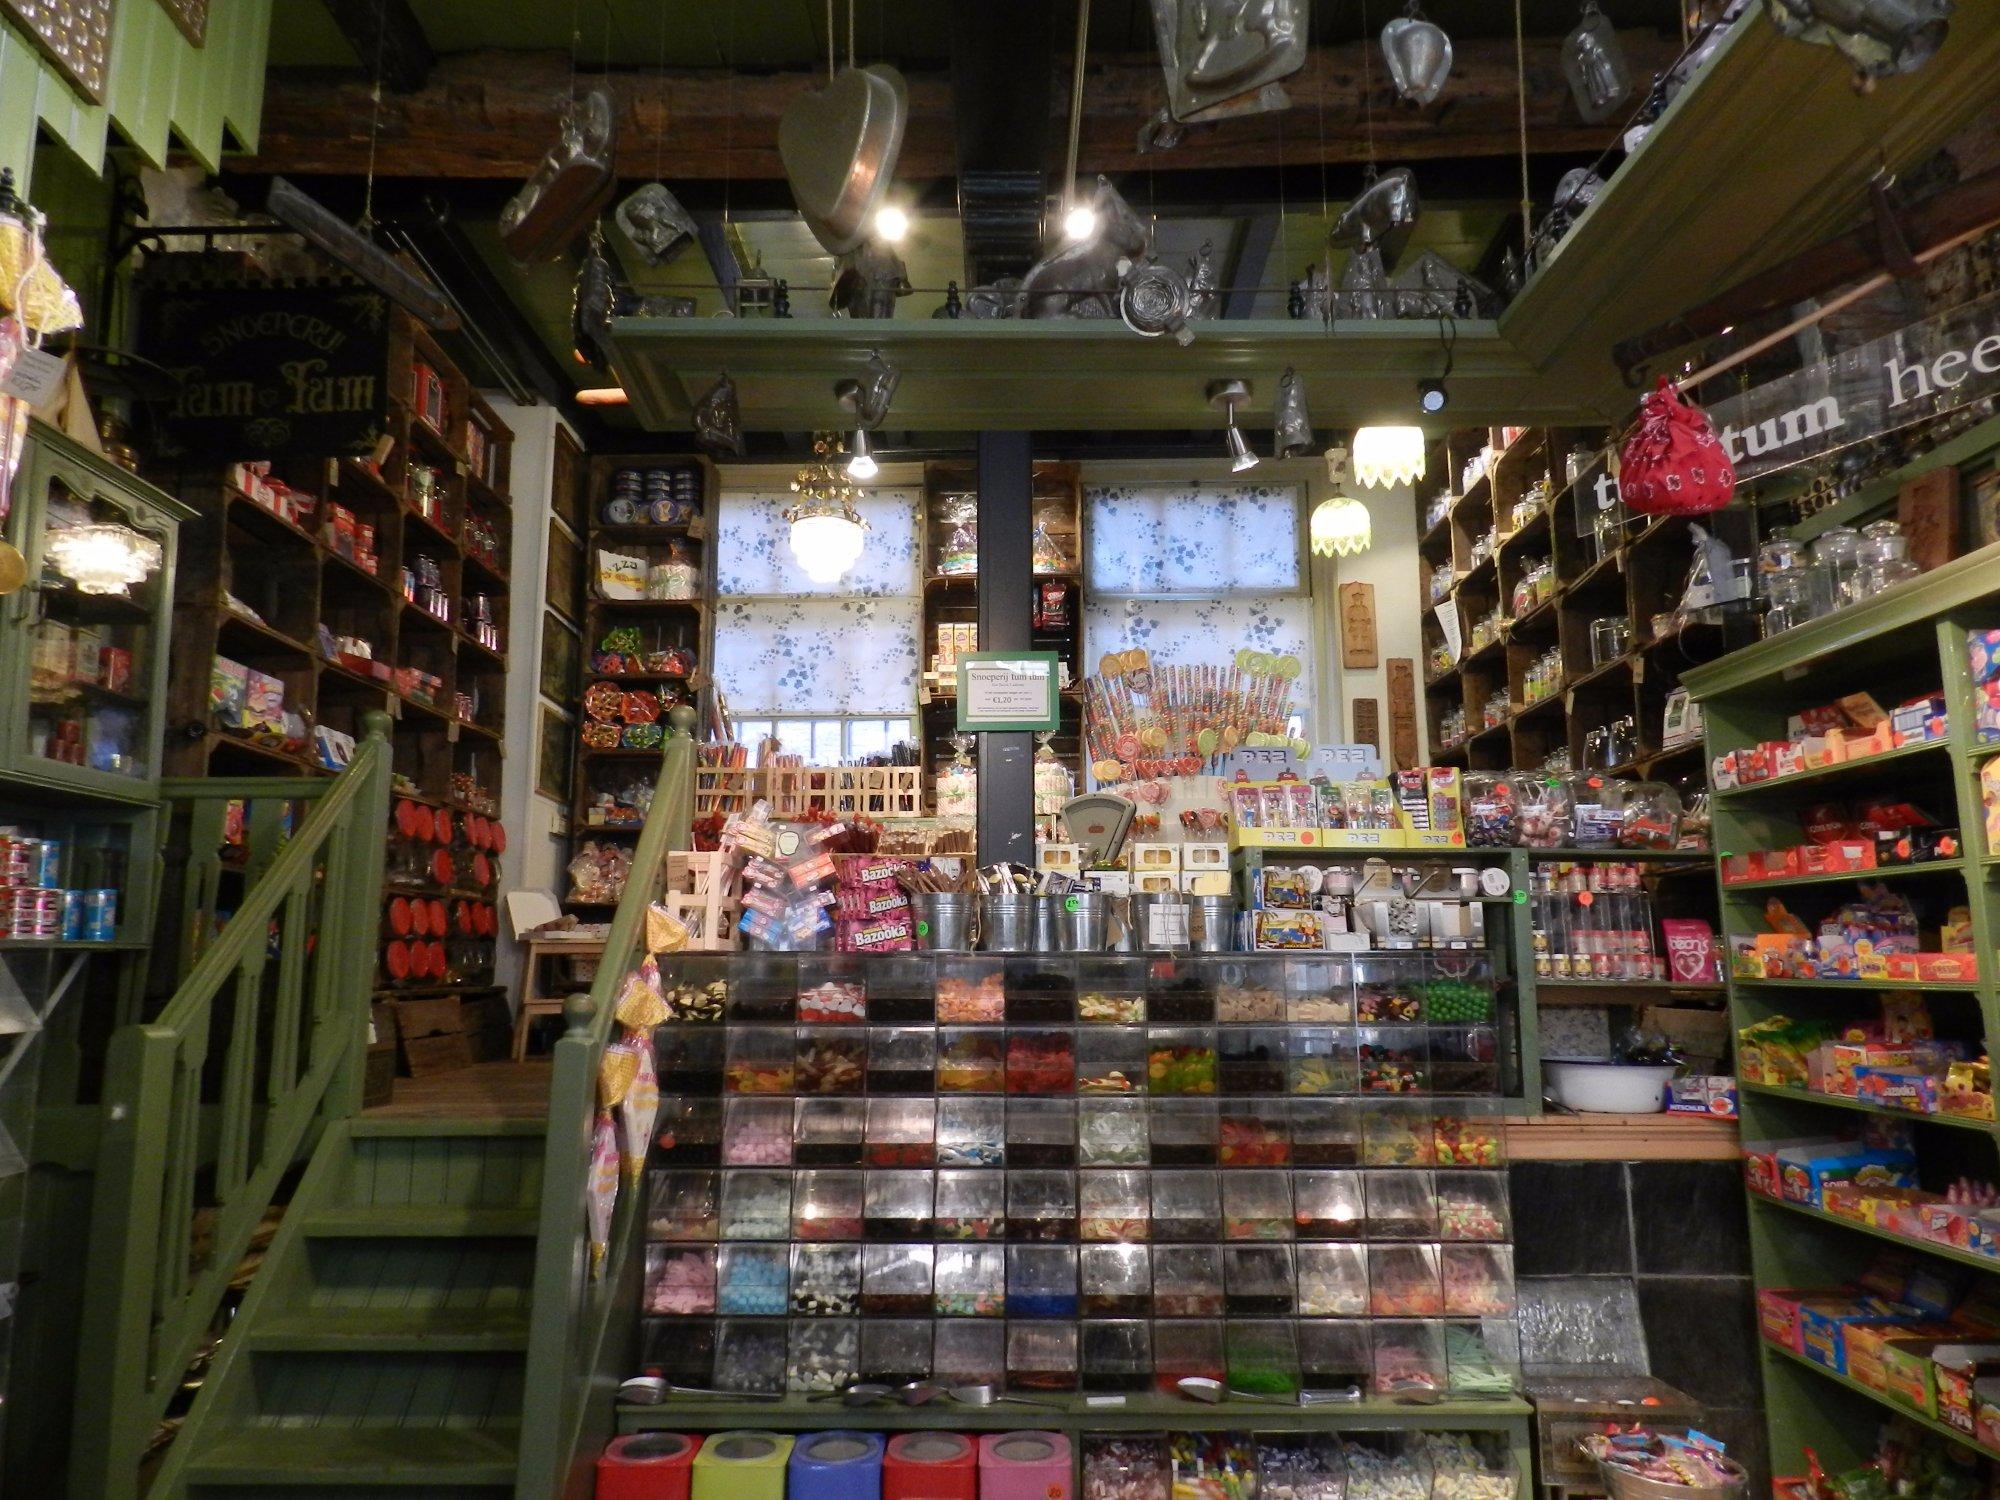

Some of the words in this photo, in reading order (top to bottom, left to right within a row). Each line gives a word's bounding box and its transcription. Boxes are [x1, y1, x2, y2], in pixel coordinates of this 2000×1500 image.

[1719, 396, 1845, 465] tum
[971, 673, 1009, 682] Snoeperij
[1241, 749, 1287, 764] PEZ
[1319, 748, 1366, 764] PEZ
[1262, 831, 1296, 843] PEZ
[1347, 833, 1380, 844] PEZ
[1423, 835, 1448, 844] PEZ
[869, 894, 908, 914] Bazooka
[855, 925, 907, 946] Bazooka
